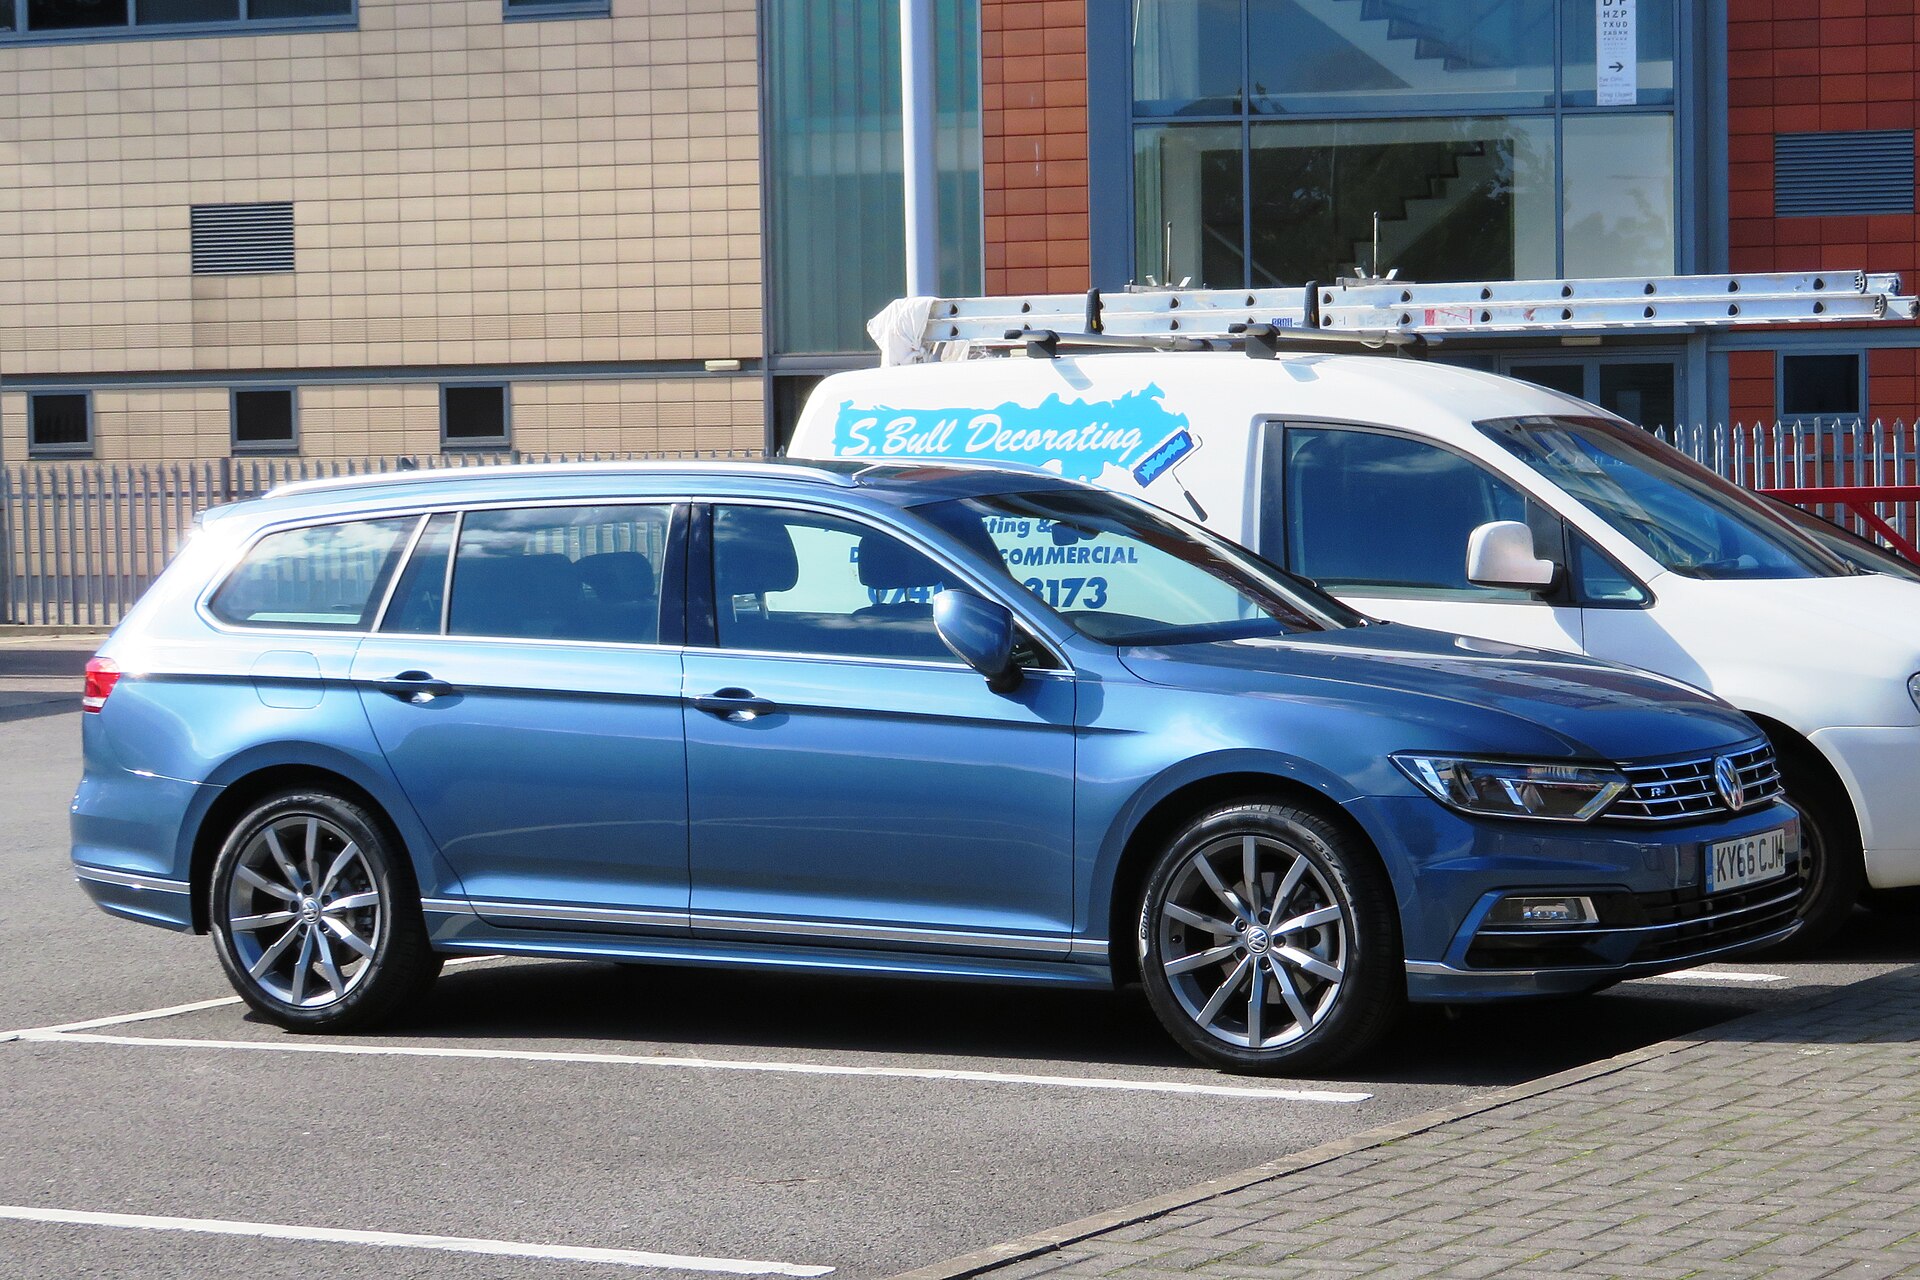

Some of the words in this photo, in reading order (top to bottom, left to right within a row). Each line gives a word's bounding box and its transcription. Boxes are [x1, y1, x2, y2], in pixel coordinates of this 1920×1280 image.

[964, 413, 1143, 462] Decorating
[1000, 546, 1138, 566] COMMERCIAL
[1716, 841, 1755, 883] KY66
